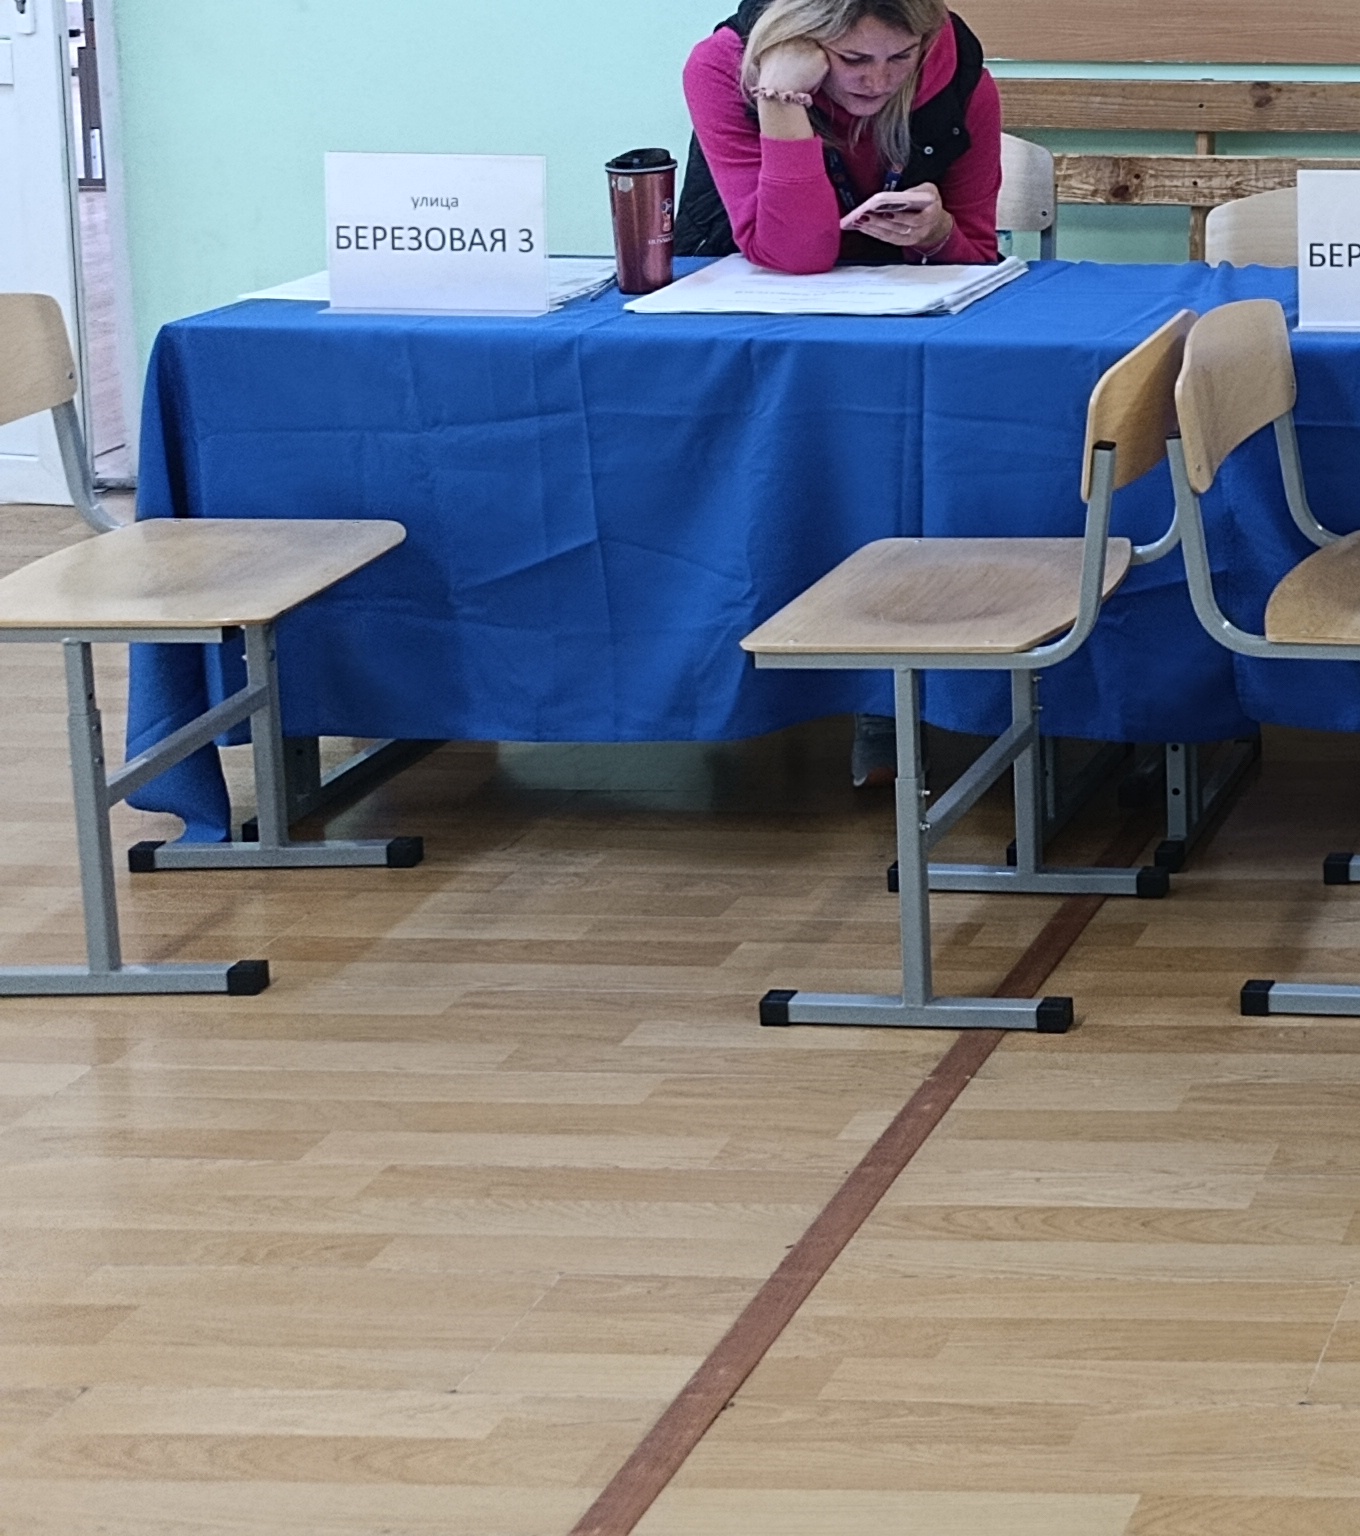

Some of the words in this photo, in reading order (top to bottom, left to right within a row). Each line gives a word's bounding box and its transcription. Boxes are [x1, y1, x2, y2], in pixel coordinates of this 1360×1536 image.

[410, 195, 460, 211] улица
[335, 224, 507, 253] БЕРЕЗОВАЯ
[517, 227, 535, 254] 3
